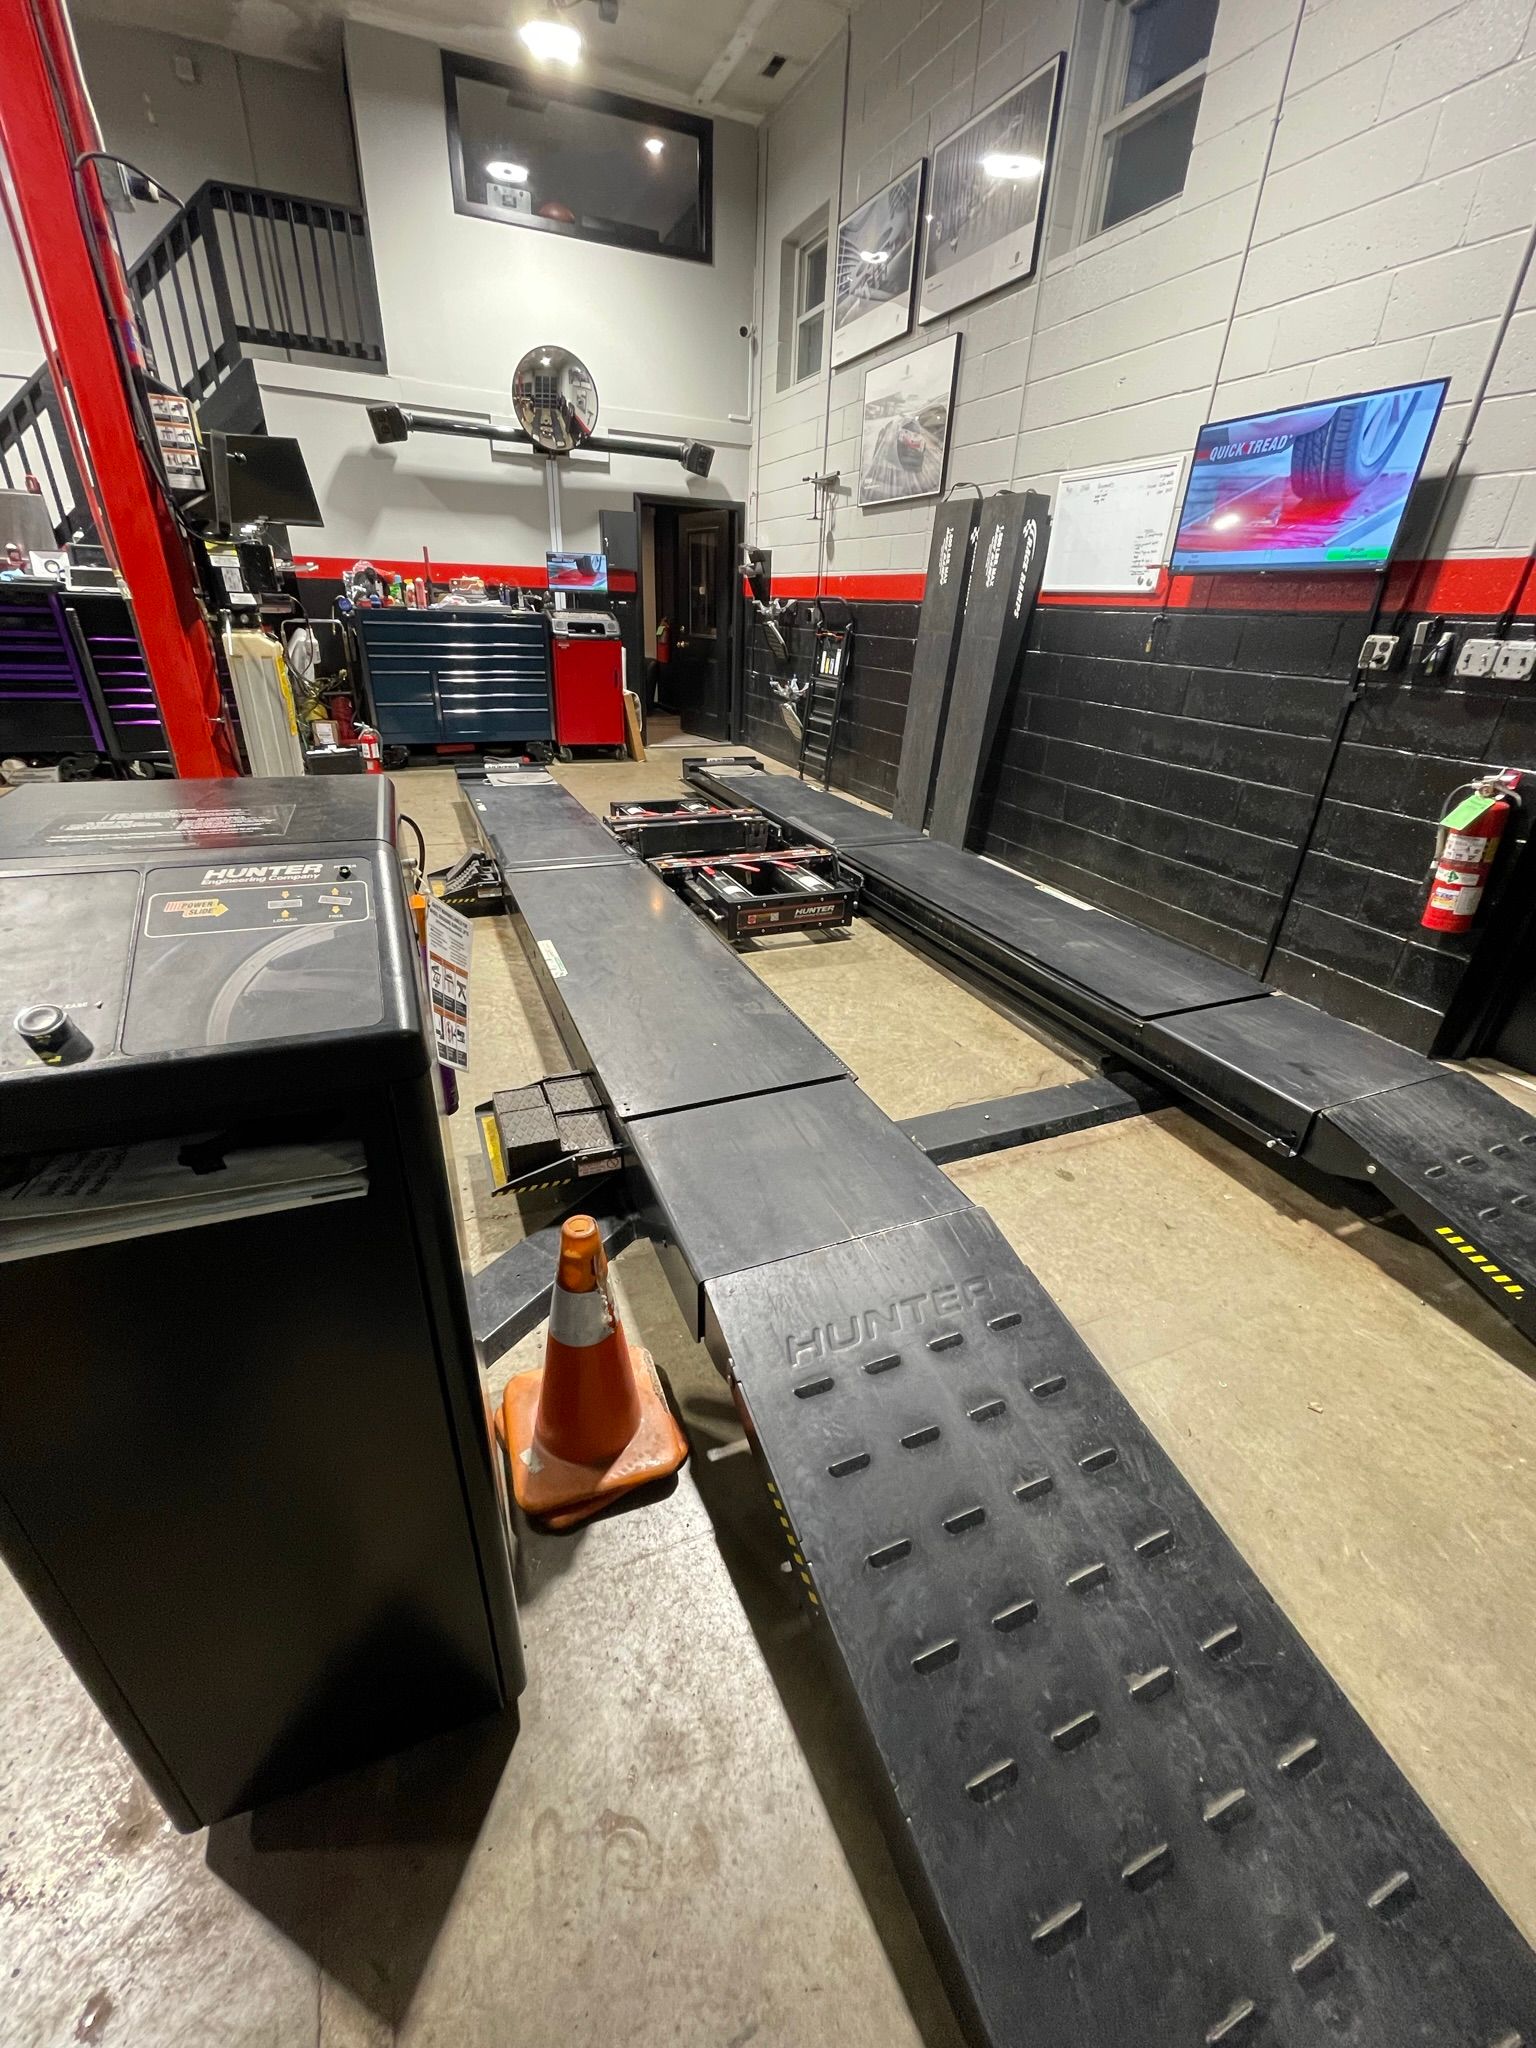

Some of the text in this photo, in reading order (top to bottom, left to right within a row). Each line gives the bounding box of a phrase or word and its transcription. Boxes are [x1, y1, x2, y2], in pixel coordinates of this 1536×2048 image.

[1209, 434, 1288, 462] QUICK TREAD
[1013, 571, 1027, 619] RAMPS
[203, 864, 324, 879] HUNTER
[201, 873, 321, 886] Engineering Company
[180, 900, 214, 909] POWER
[188, 907, 215, 916] SLIDE
[795, 905, 835, 915] HUNTER
[785, 1275, 997, 1369] HUNTER
